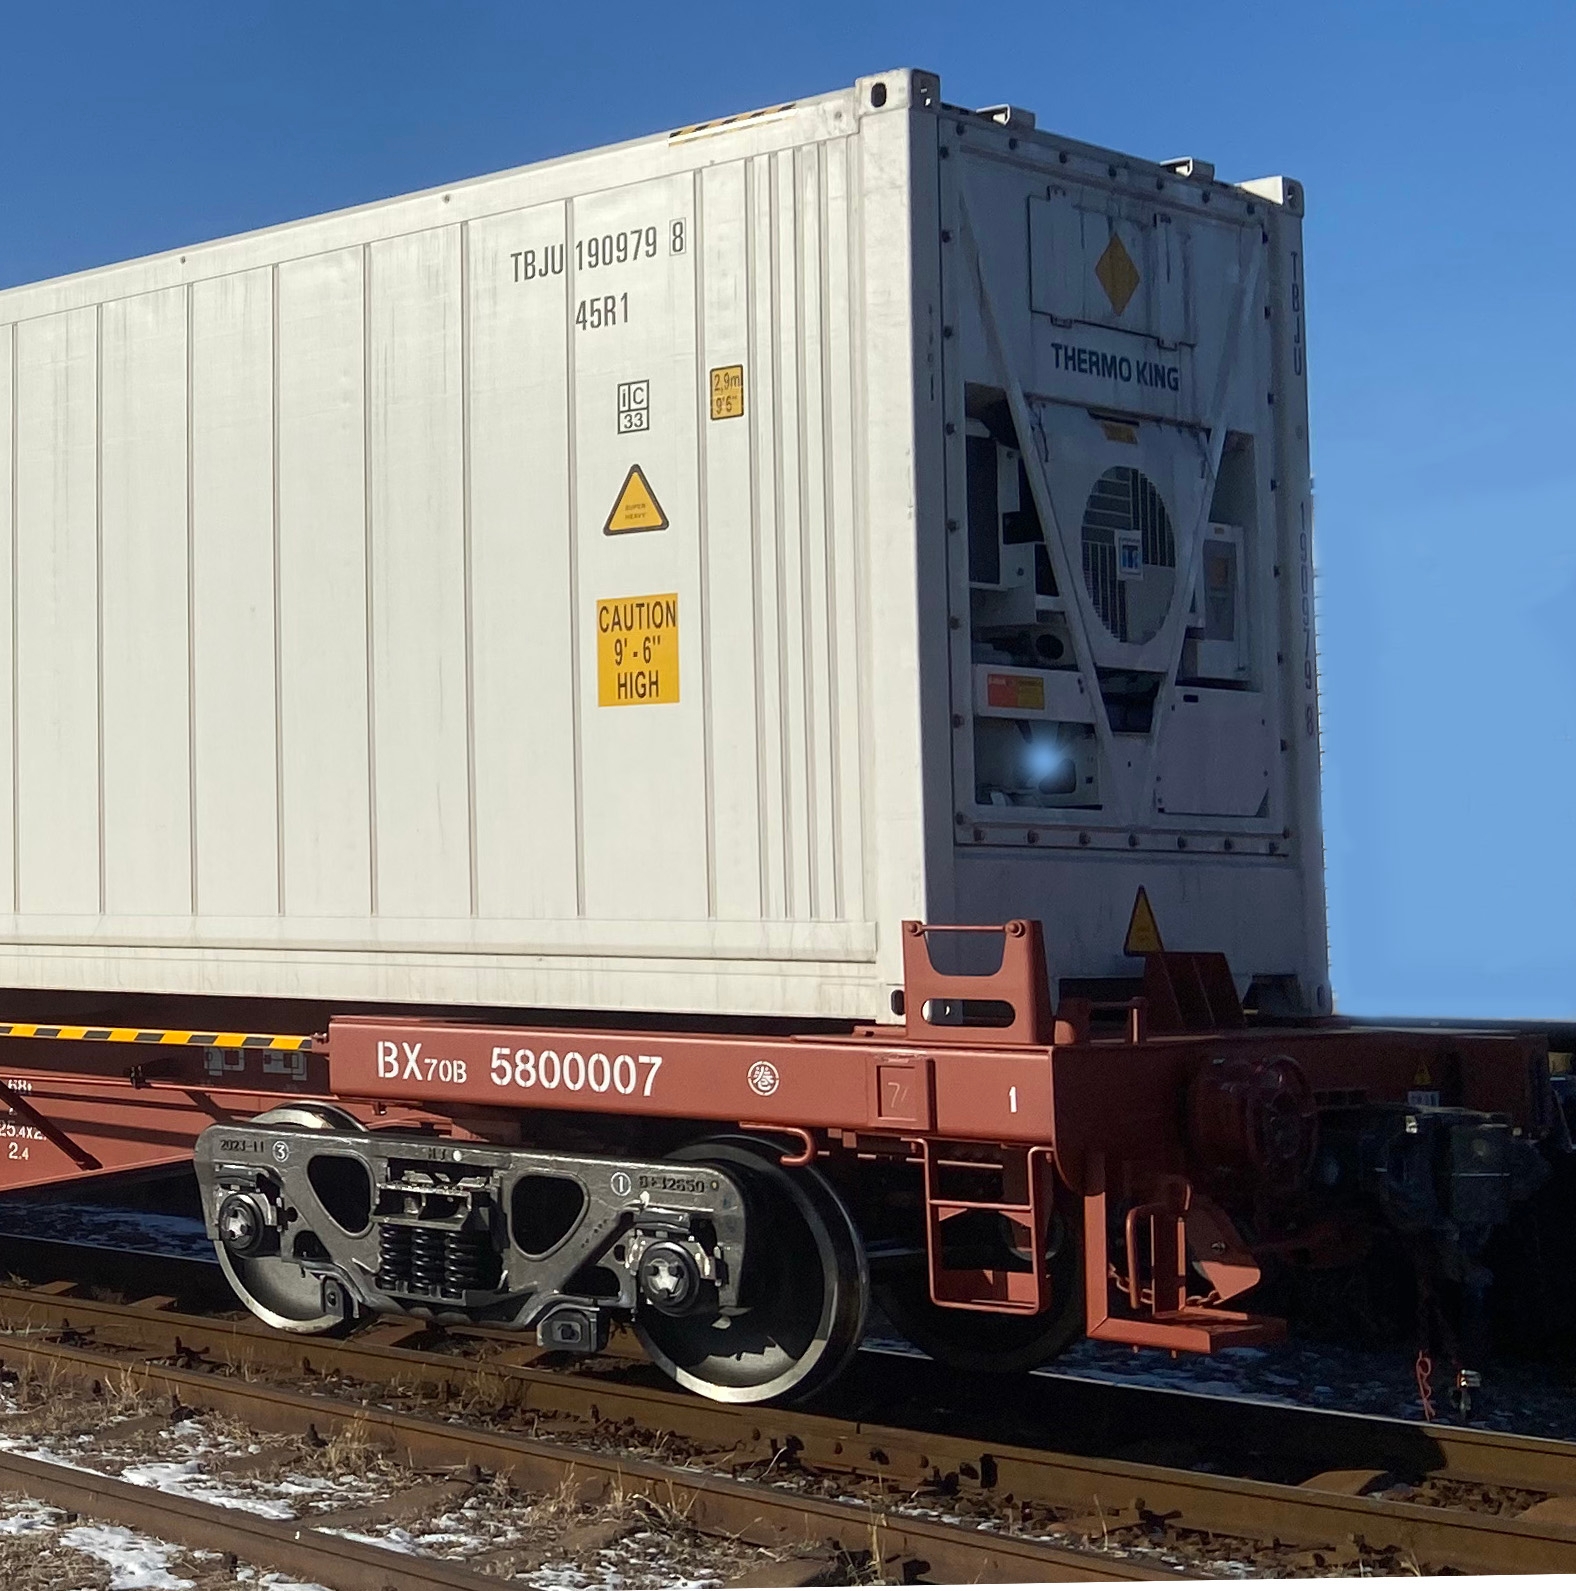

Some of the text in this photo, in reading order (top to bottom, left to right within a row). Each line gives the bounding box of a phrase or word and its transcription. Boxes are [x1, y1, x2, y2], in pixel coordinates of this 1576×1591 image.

[510, 221, 684, 282] TBJU 190979 8
[576, 292, 628, 331] 45R1
[1291, 251, 1302, 376] TBJU
[1051, 342, 1179, 391] THERMO KING
[624, 412, 644, 429] 33
[598, 600, 676, 633] CAUTION
[617, 669, 660, 700] HIGH
[377, 1040, 663, 1097] BX70B 5800007
[1008, 1085, 1017, 1114] 1
[8, 1142, 29, 1161] 2.4
